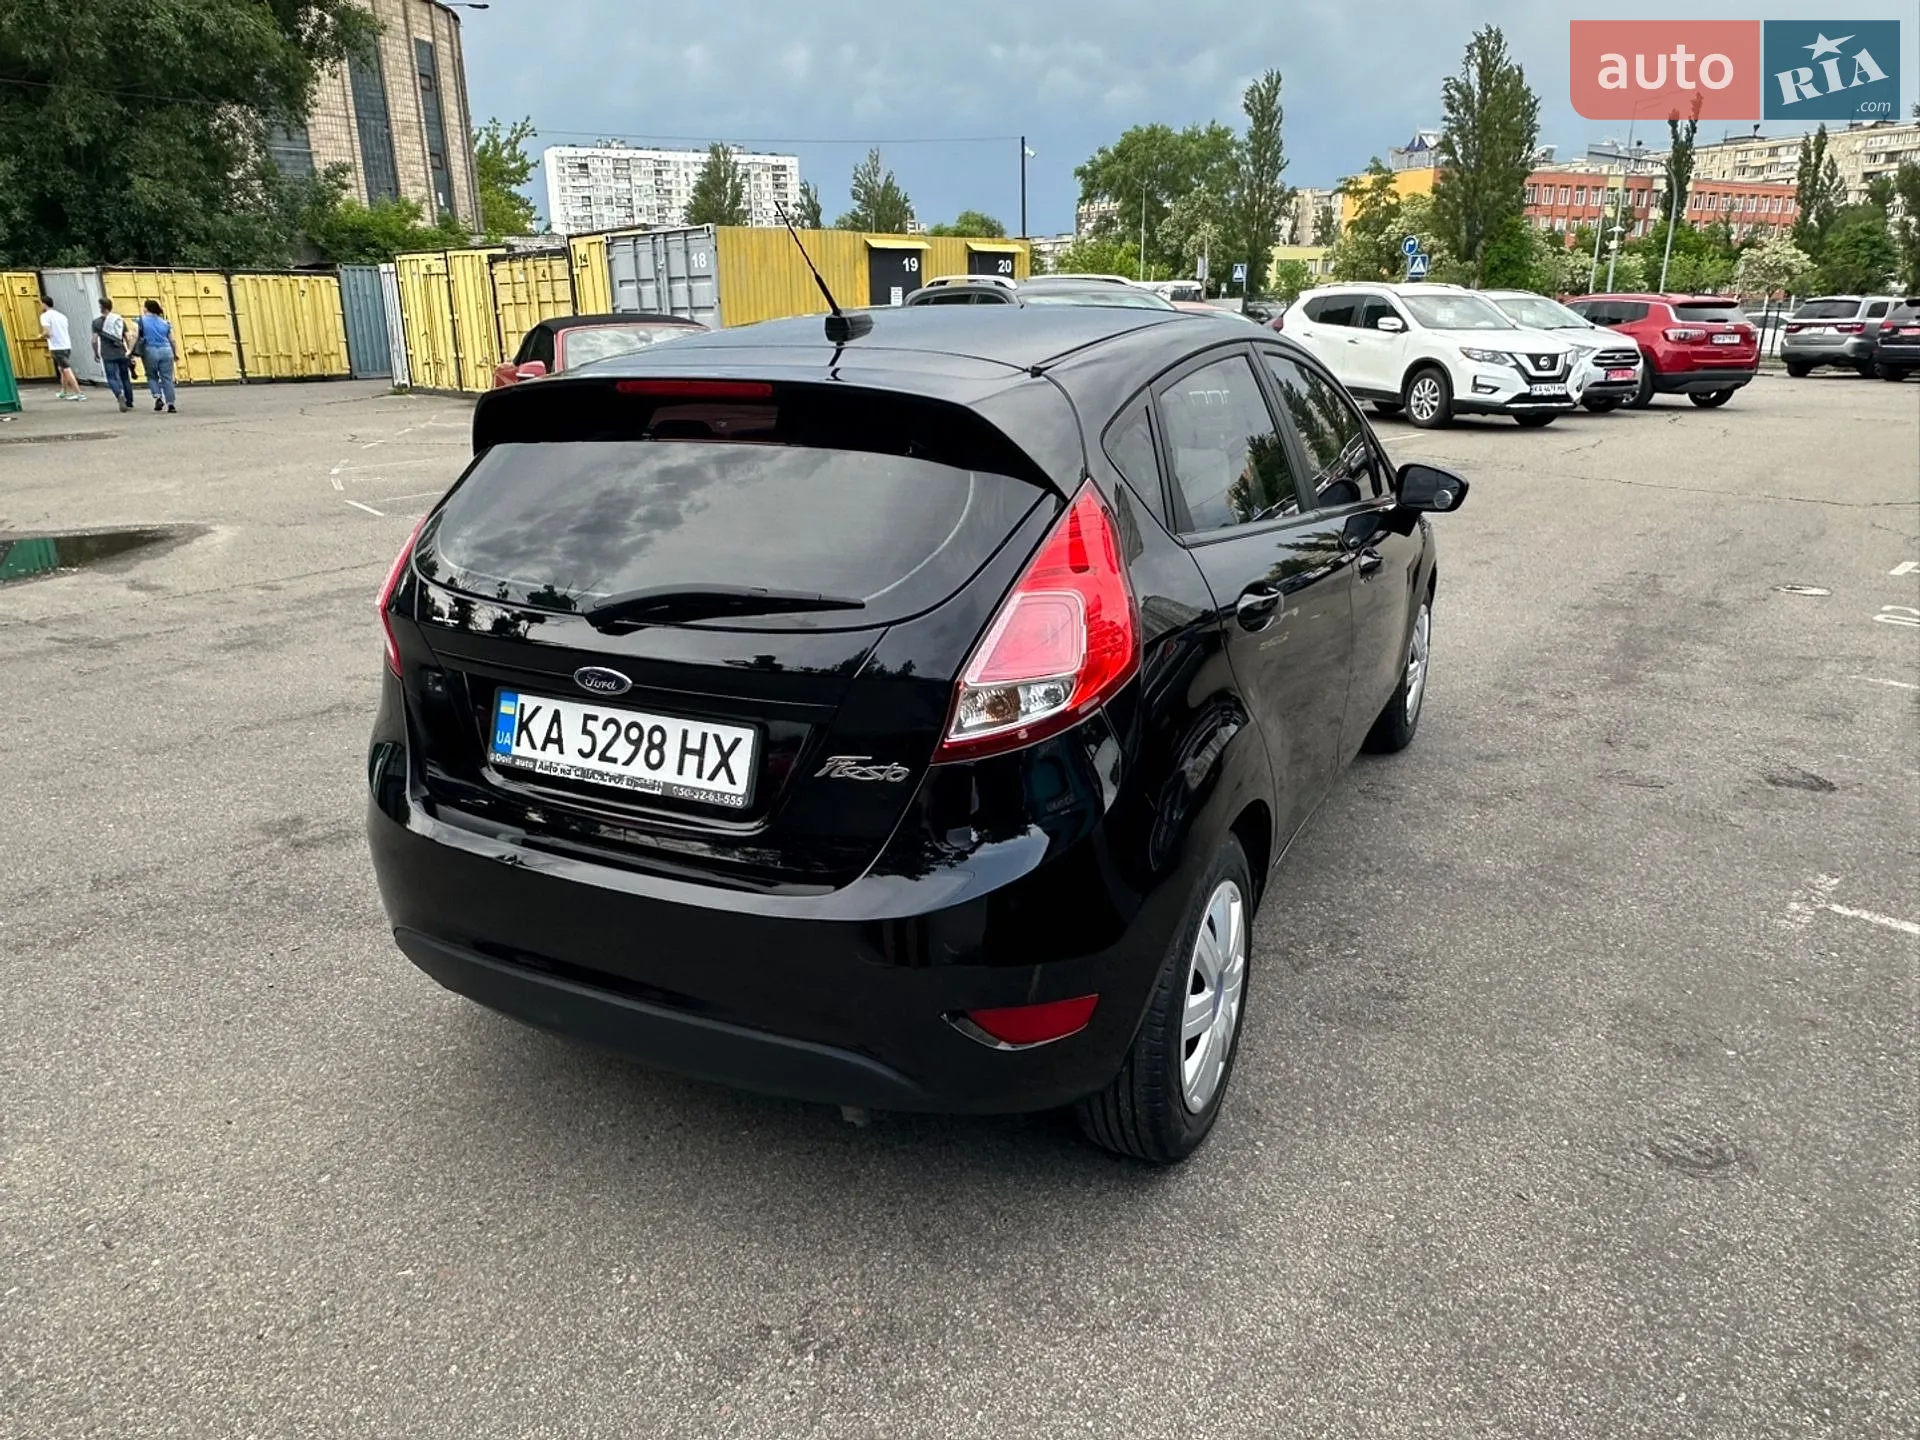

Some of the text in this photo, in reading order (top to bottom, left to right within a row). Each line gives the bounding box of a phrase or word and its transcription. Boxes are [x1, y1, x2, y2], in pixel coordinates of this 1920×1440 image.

[692, 252, 706, 268] 18
[902, 257, 918, 272] 19
[998, 260, 1012, 273] 20
[21, 286, 28, 294] 5
[203, 286, 210, 294] 6
[585, 672, 617, 690] Ford
[496, 730, 511, 745] UA
[515, 703, 565, 755] KA
[577, 713, 668, 771] 5298
[676, 728, 742, 786] HX
[814, 756, 910, 782] Fiesta
